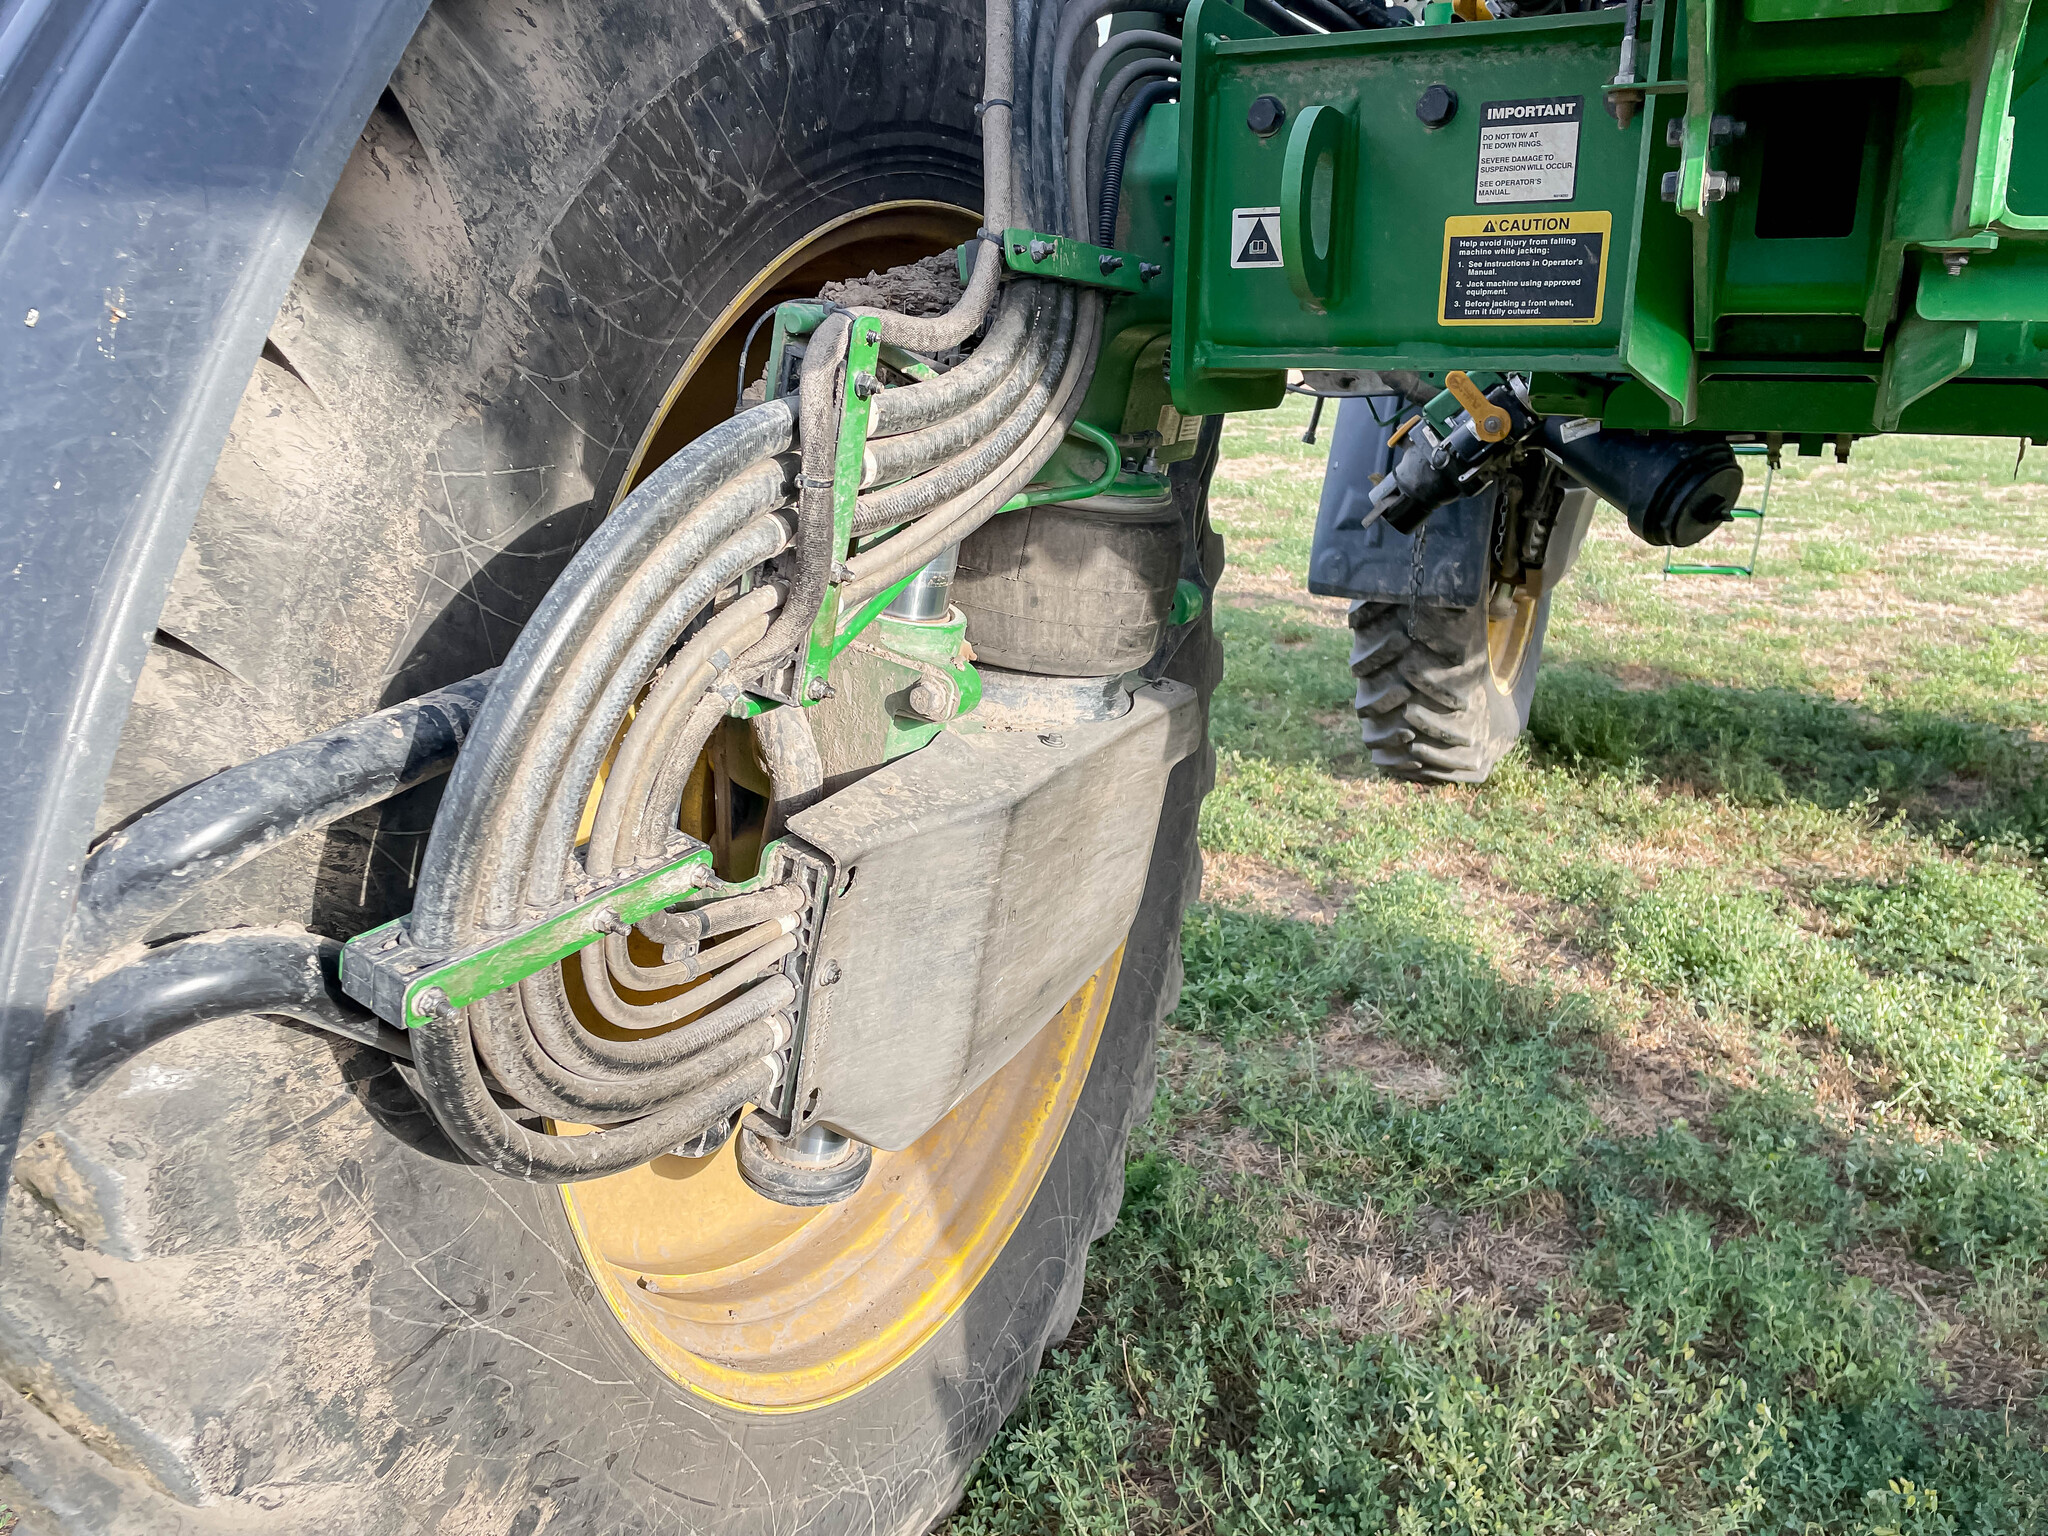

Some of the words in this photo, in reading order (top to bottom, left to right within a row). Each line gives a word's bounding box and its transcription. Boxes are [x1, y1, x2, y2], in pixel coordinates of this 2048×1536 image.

[1487, 103, 1576, 120] IMPORTANT
[1480, 165, 1527, 173] SUSPENSION
[1495, 178, 1542, 186] OPERATOR'S
[1499, 218, 1570, 231] CAUTION
[1460, 240, 1478, 248] Help
[1504, 239, 1526, 247] injury
[1550, 238, 1576, 246] falling
[1517, 248, 1550, 256] jacking:
[1542, 259, 1583, 267] Operator's
[1544, 279, 1581, 288] approved
[1492, 301, 1519, 309] jacking
[1489, 308, 1506, 316] fully
